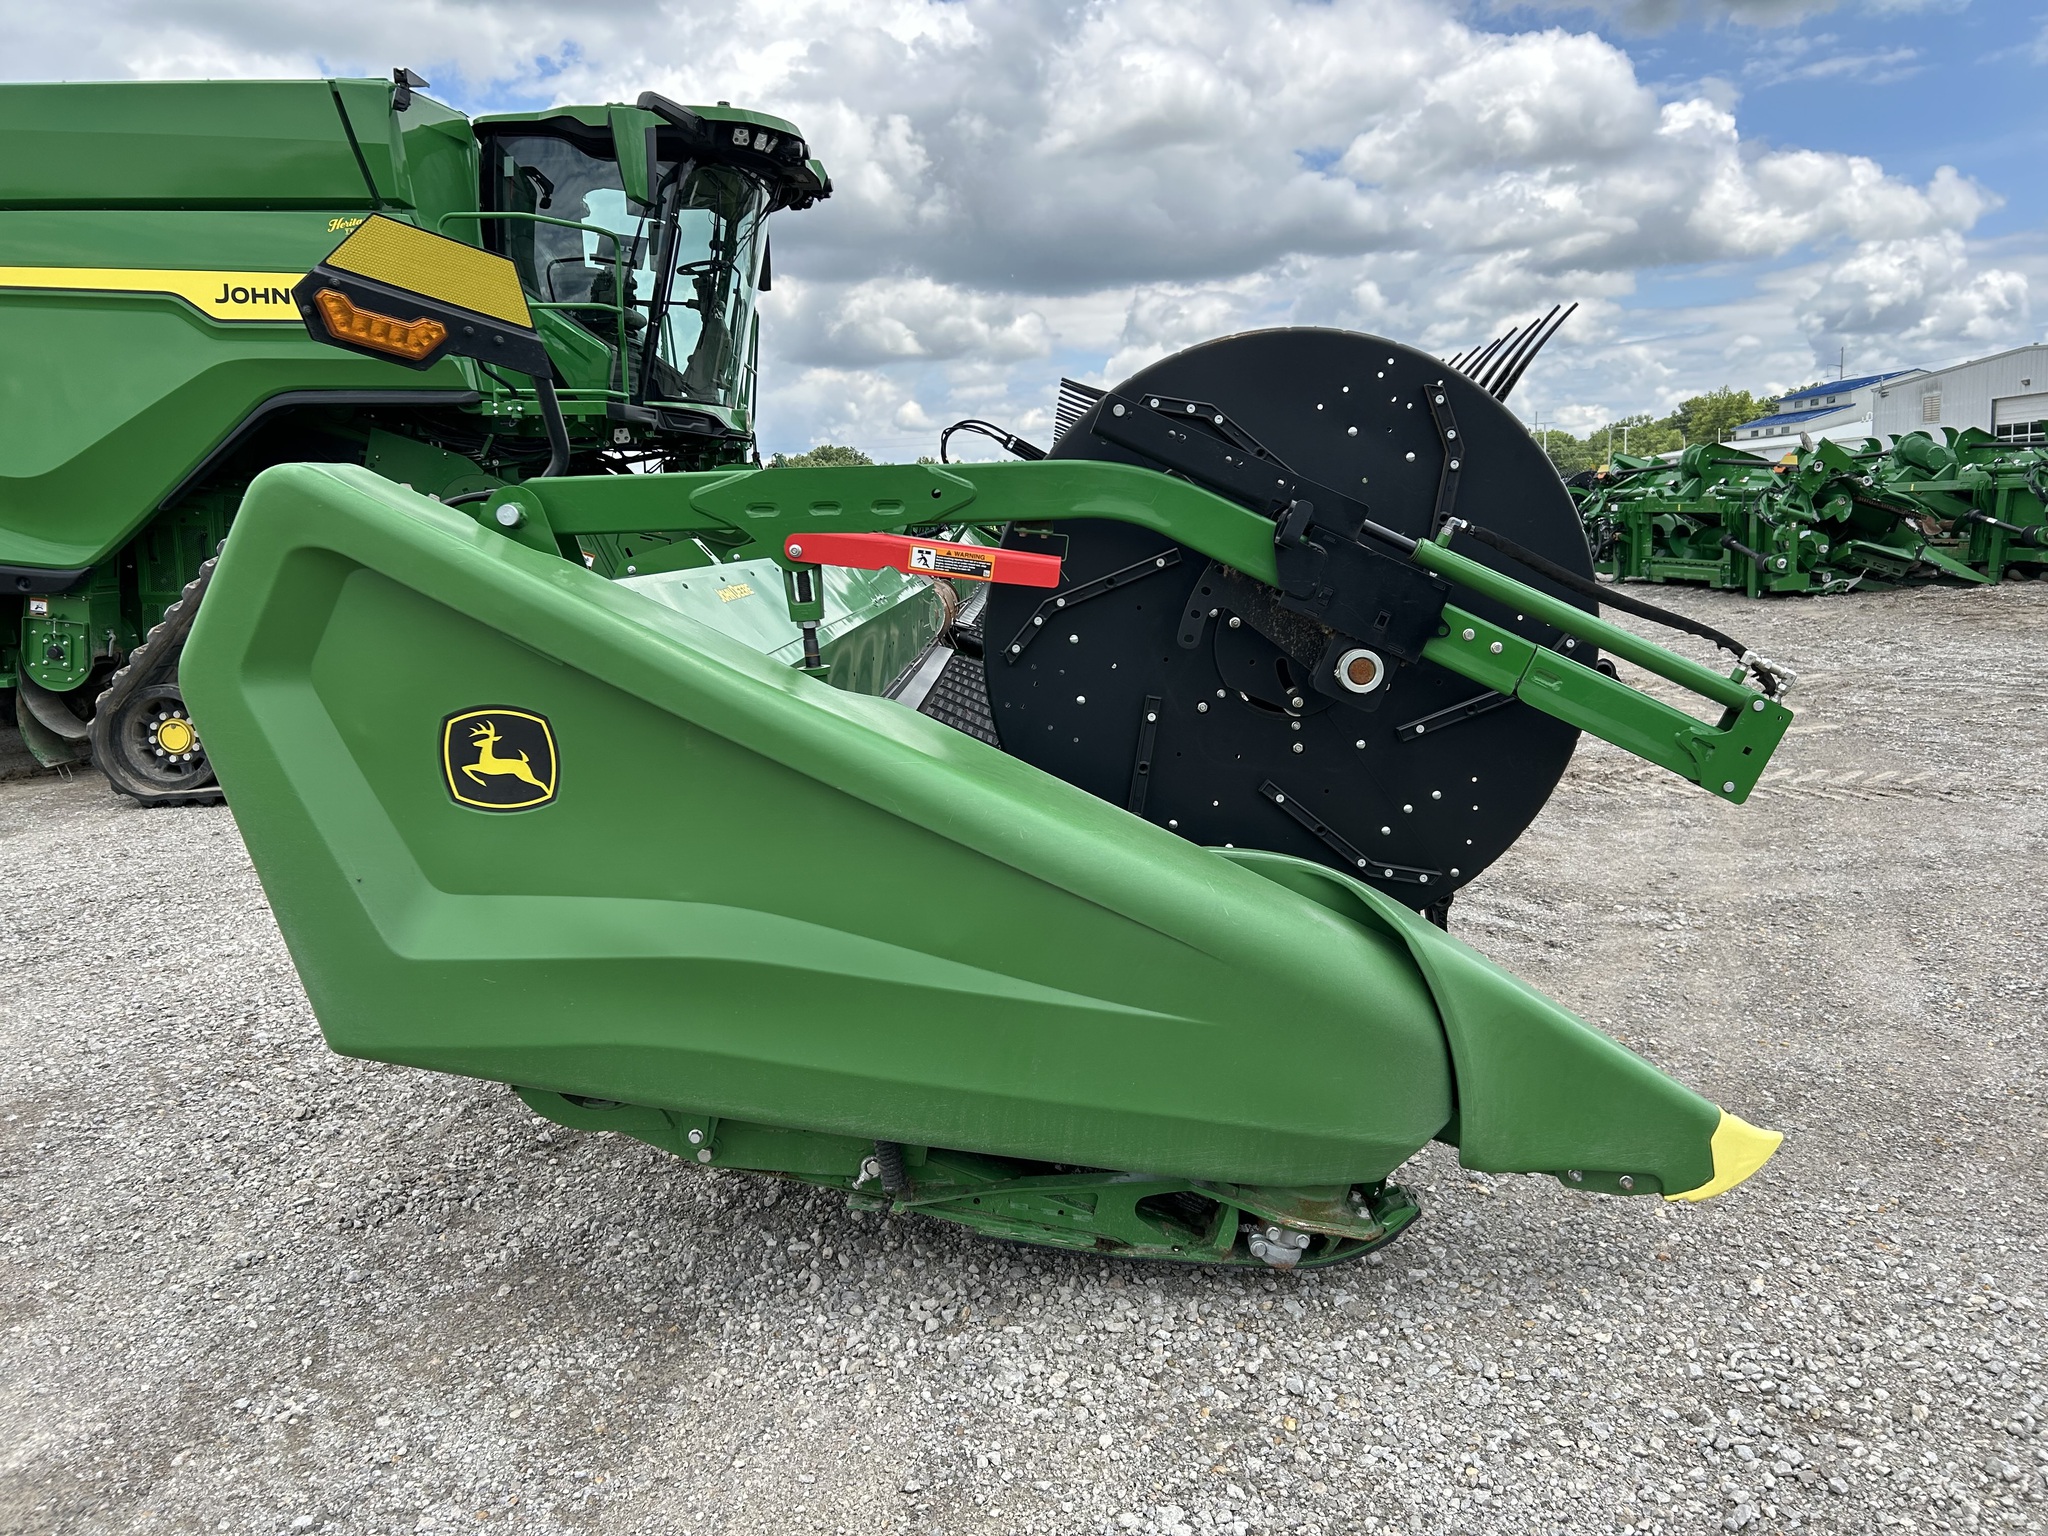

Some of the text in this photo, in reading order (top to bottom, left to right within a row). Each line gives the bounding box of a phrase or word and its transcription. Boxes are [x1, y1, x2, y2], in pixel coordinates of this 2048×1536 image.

[327, 217, 363, 232] Herita
[215, 284, 290, 304] JOHN
[954, 551, 986, 561] WARNING
